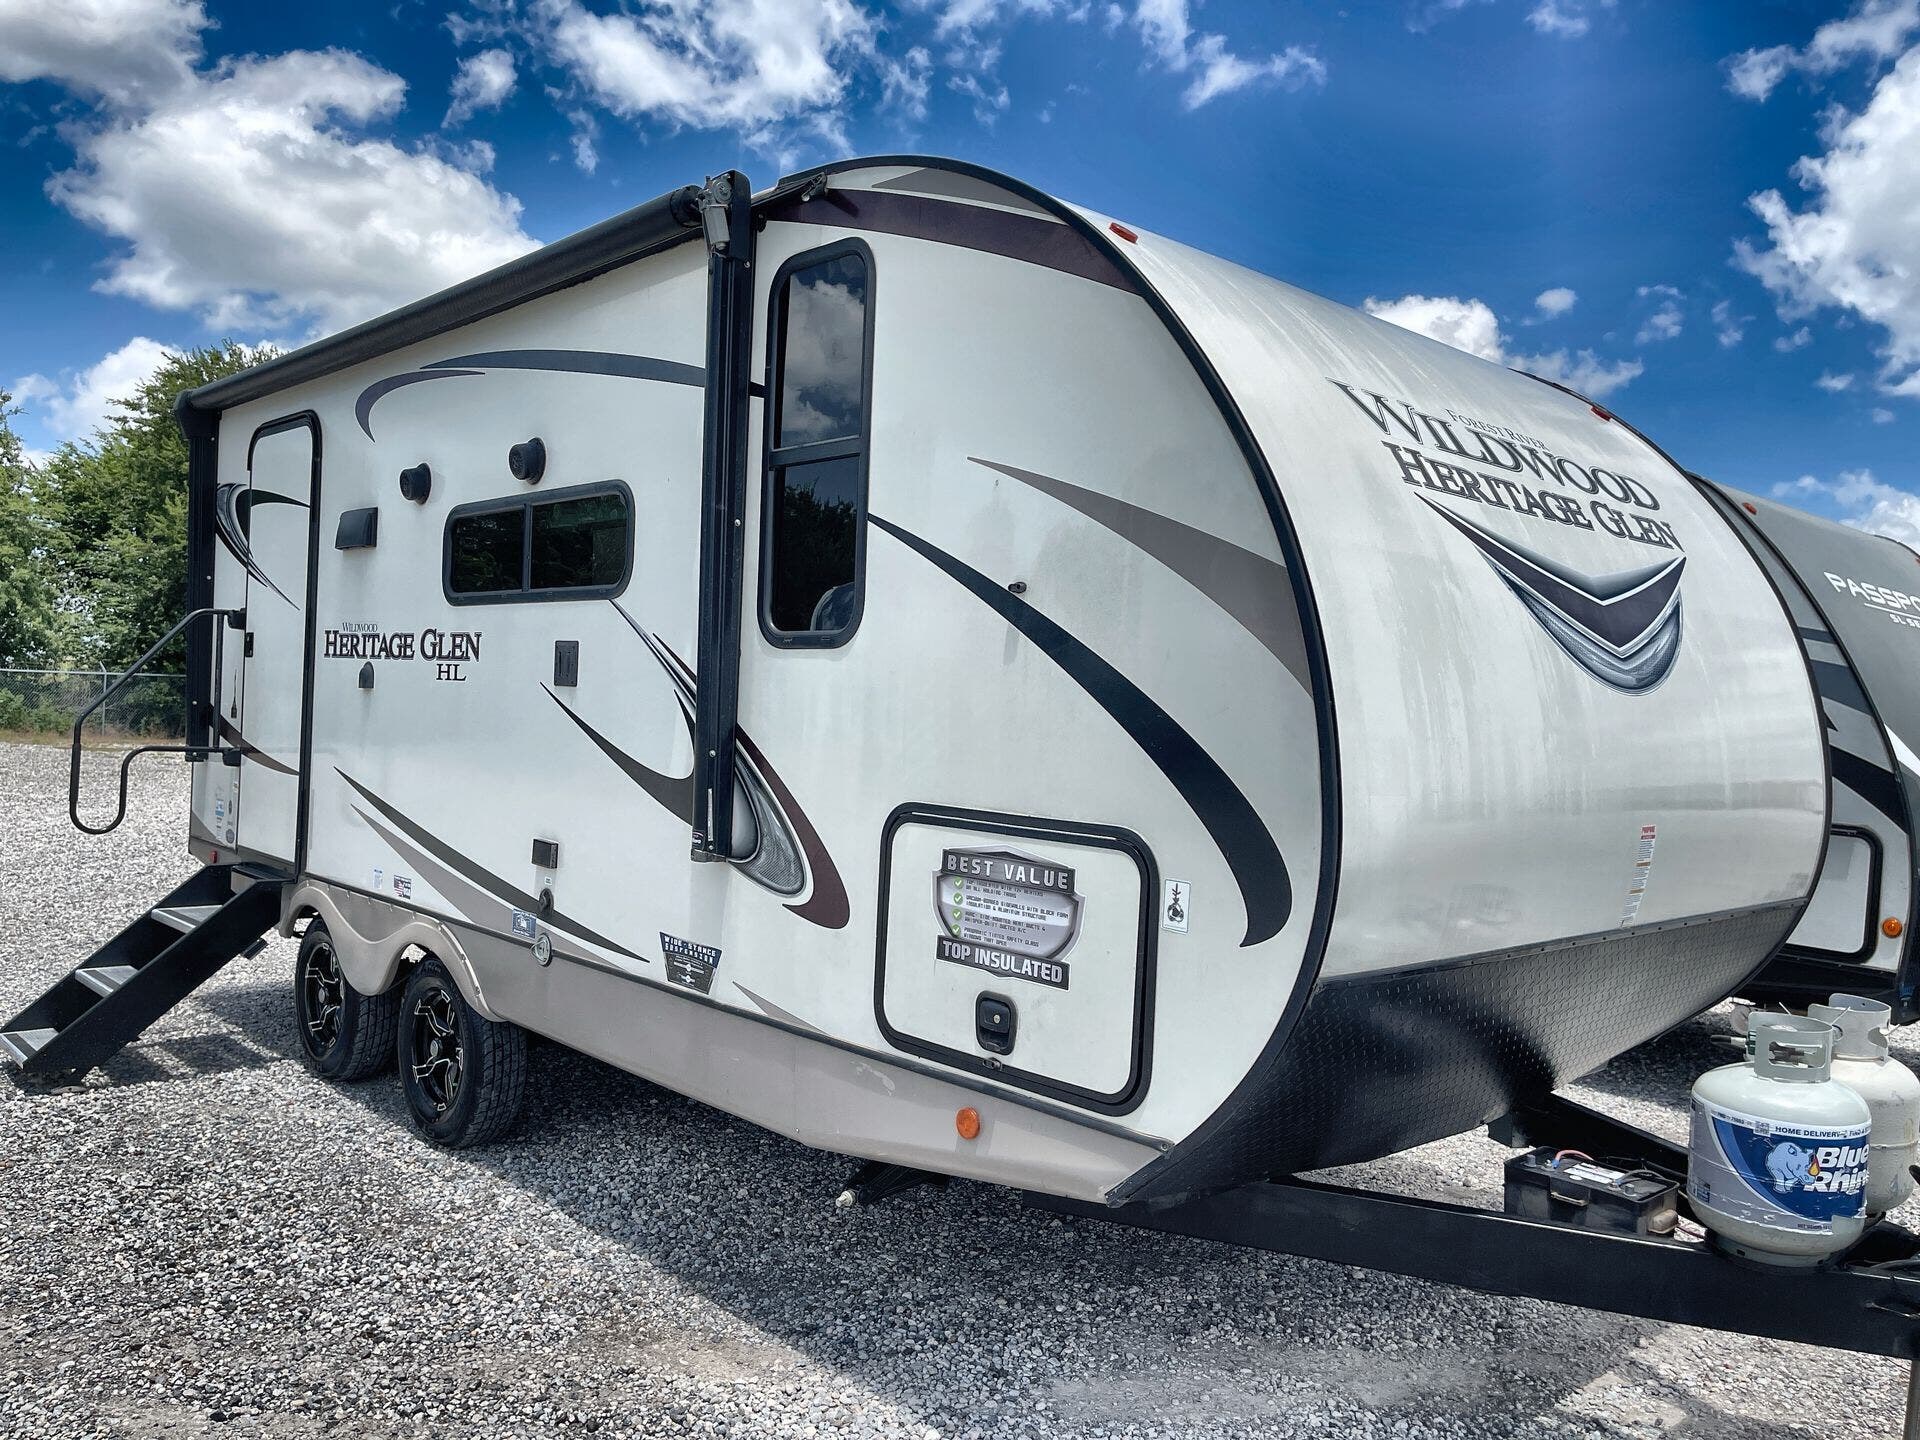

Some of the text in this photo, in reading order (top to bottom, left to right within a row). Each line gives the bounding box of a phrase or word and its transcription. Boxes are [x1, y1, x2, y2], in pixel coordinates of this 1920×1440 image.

[1325, 376, 1661, 511] WILDWOOD
[1381, 440, 1685, 552] HERITAGE GLEN
[342, 622, 378, 633] WILDWOOD
[324, 628, 482, 662] HERITAGE GLEN
[436, 663, 467, 681] HL
[947, 854, 1068, 890] BEST VALUE
[943, 940, 1063, 984] TOP INSULATED
[1775, 1126, 1801, 1135] HOME
[1816, 1144, 1870, 1168] Blue
[1803, 1168, 1869, 1192] Rhin
